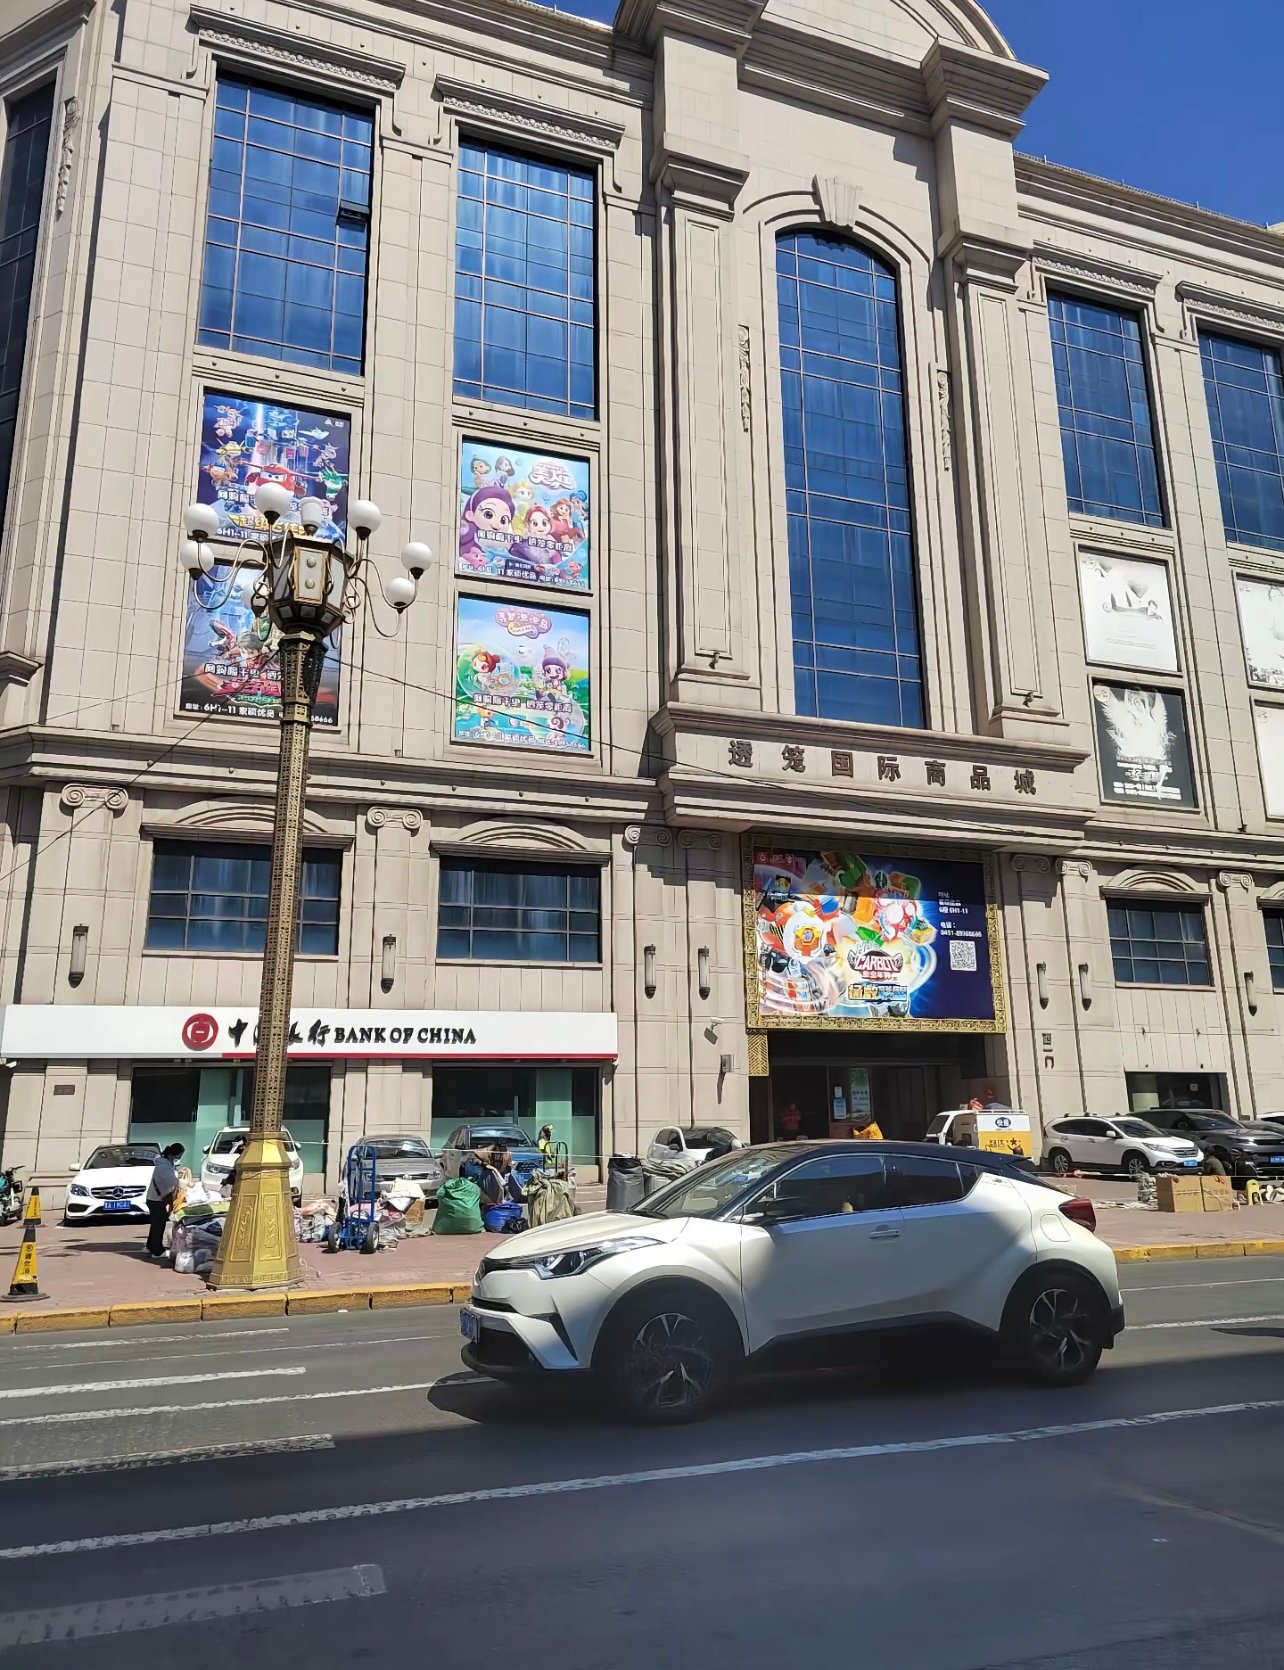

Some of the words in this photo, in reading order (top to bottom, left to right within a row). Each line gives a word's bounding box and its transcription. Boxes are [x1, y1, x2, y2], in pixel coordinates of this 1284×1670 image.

[728, 739, 1037, 796] 透笼国际商品城
[228, 1018, 330, 1048] 中行
[334, 1027, 387, 1044] BANK
[390, 1027, 413, 1044] OF
[417, 1027, 476, 1044] CHINA
